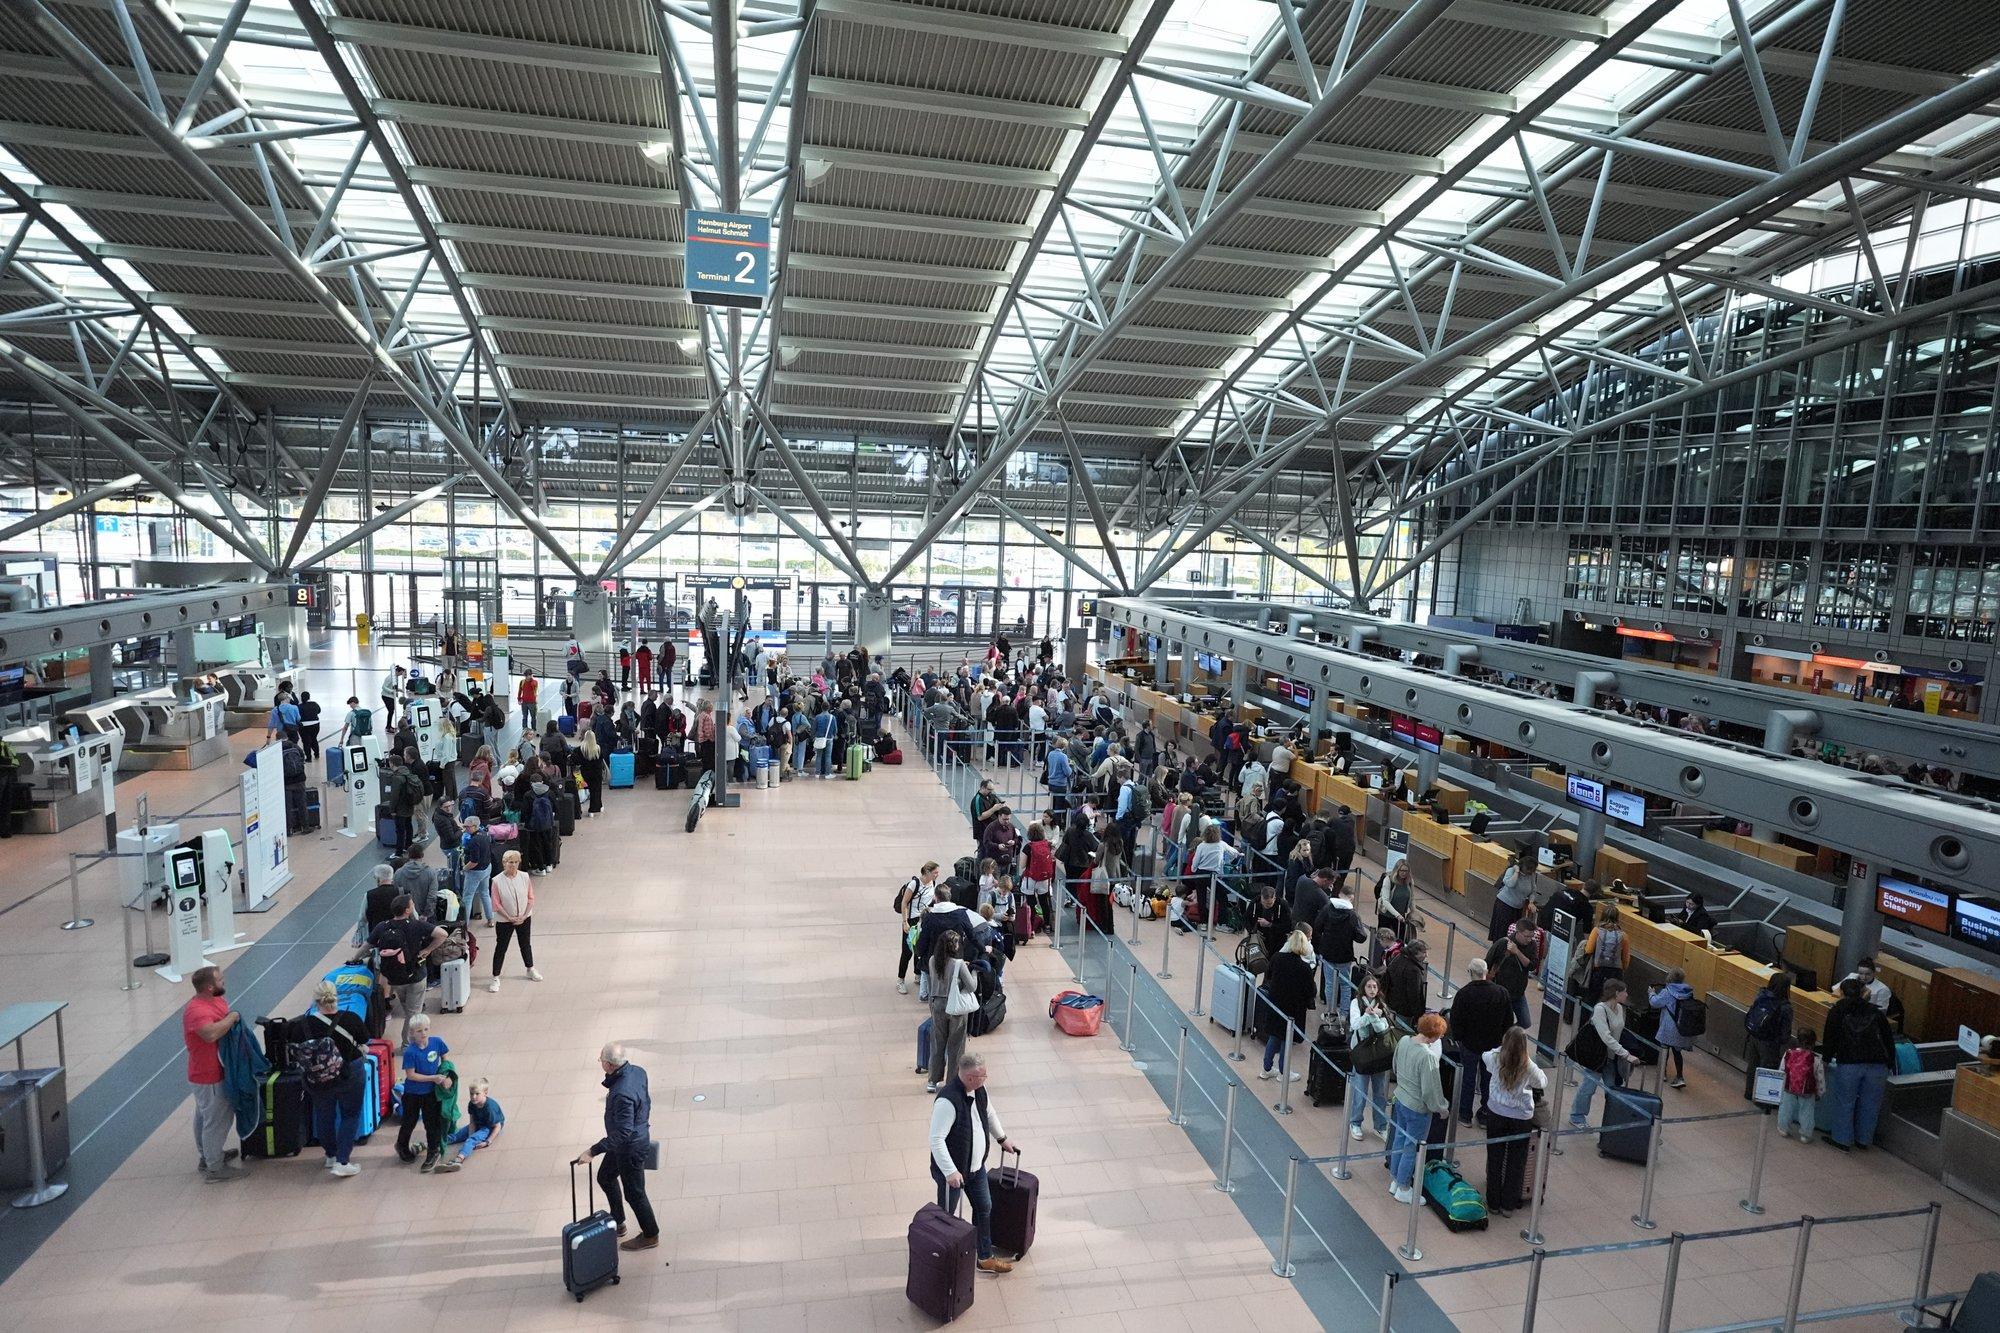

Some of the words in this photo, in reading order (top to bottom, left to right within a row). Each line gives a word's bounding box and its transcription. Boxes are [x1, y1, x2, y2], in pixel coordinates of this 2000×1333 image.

[698, 218, 728, 228] Hamburg
[728, 221, 752, 230] Airport
[698, 226, 721, 235] Helmut
[722, 228, 749, 237] Schmidt
[698, 271, 730, 282] Terminal
[734, 251, 756, 284] 2
[297, 588, 307, 601] 8
[1083, 601, 1090, 612] 9
[1608, 805, 1629, 816] Drop-off
[184, 901, 190, 911] 1
[1883, 891, 1922, 912] Economy
[1883, 900, 1907, 914] Class
[1961, 917, 2000, 937] Busines
[1961, 926, 1988, 941] Class
